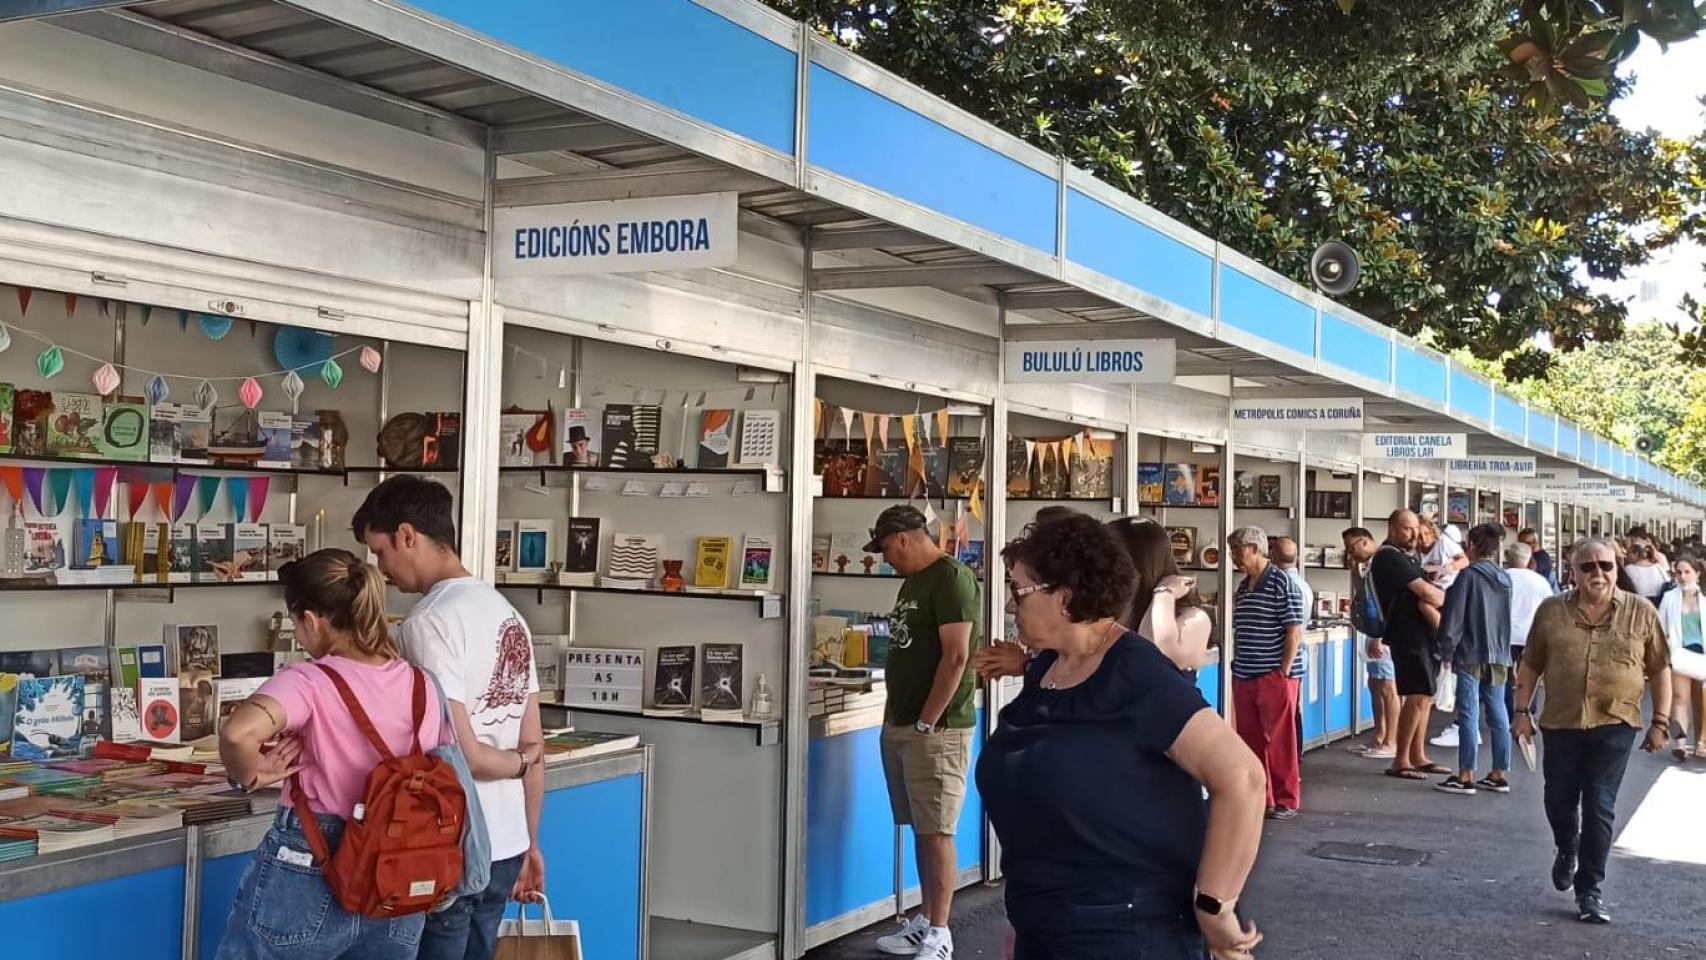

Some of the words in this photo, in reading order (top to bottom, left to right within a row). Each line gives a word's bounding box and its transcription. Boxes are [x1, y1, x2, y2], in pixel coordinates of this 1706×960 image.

[514, 219, 611, 259] EDICIÓNS
[617, 218, 710, 255] EMBORA
[1023, 347, 1082, 372] BULULÚ
[1087, 351, 1143, 372] LIBROS
[1234, 407, 1285, 419] METRÓPOLIS
[1286, 408, 1318, 419] COMICS
[1319, 408, 1325, 418] A
[1327, 406, 1361, 418] CORUÑA
[1375, 435, 1417, 446] EDITORIAL
[1419, 435, 1452, 446] CANELA
[1387, 446, 1416, 457] LIBROS
[1417, 446, 1434, 457] LAR
[1450, 459, 1487, 471] LIBRERÍA
[1609, 488, 1626, 496] MICS
[568, 653, 642, 666] PRESENTA
[594, 672, 613, 683] AS
